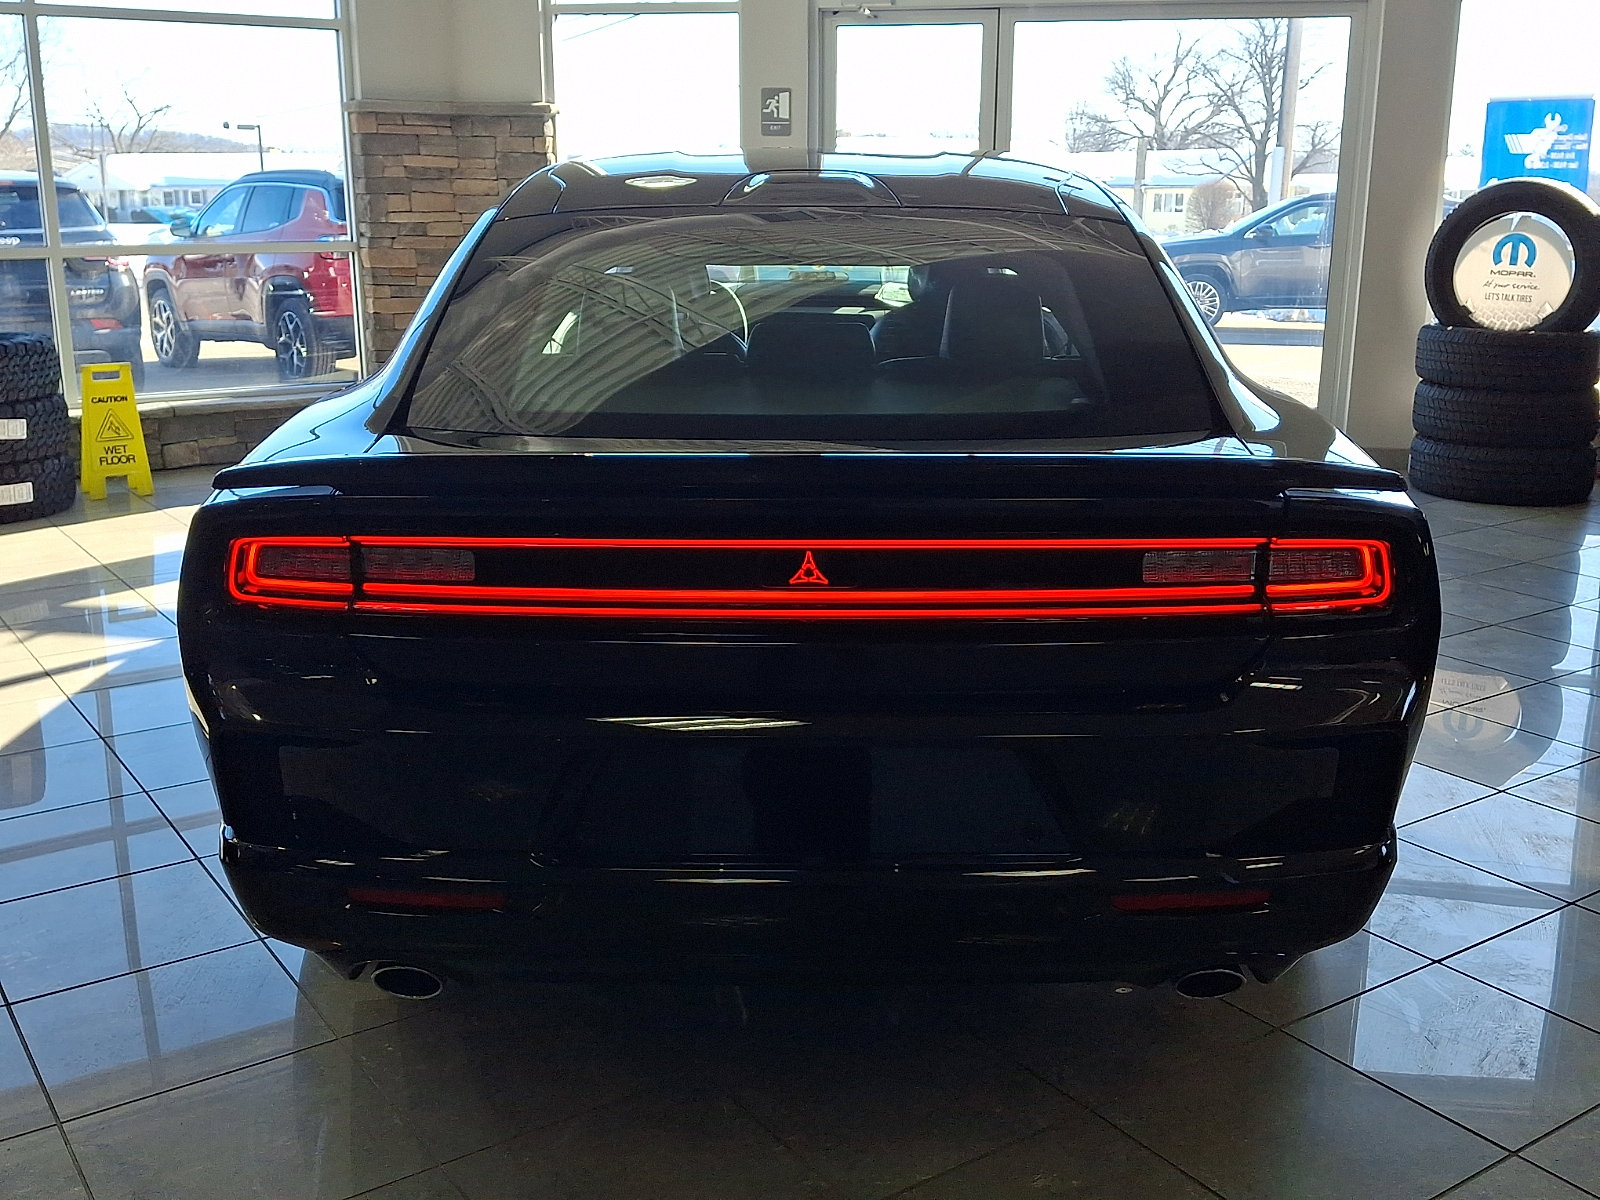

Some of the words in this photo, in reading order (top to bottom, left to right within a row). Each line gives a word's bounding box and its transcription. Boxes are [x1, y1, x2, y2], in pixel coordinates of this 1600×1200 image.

[1484, 292, 1500, 301] LET'S
[1501, 293, 1515, 302] TALK
[1516, 294, 1533, 303] TIRES
[91, 395, 128, 404] CAUTION
[104, 444, 128, 455] WET
[99, 454, 136, 466] FLOOR
